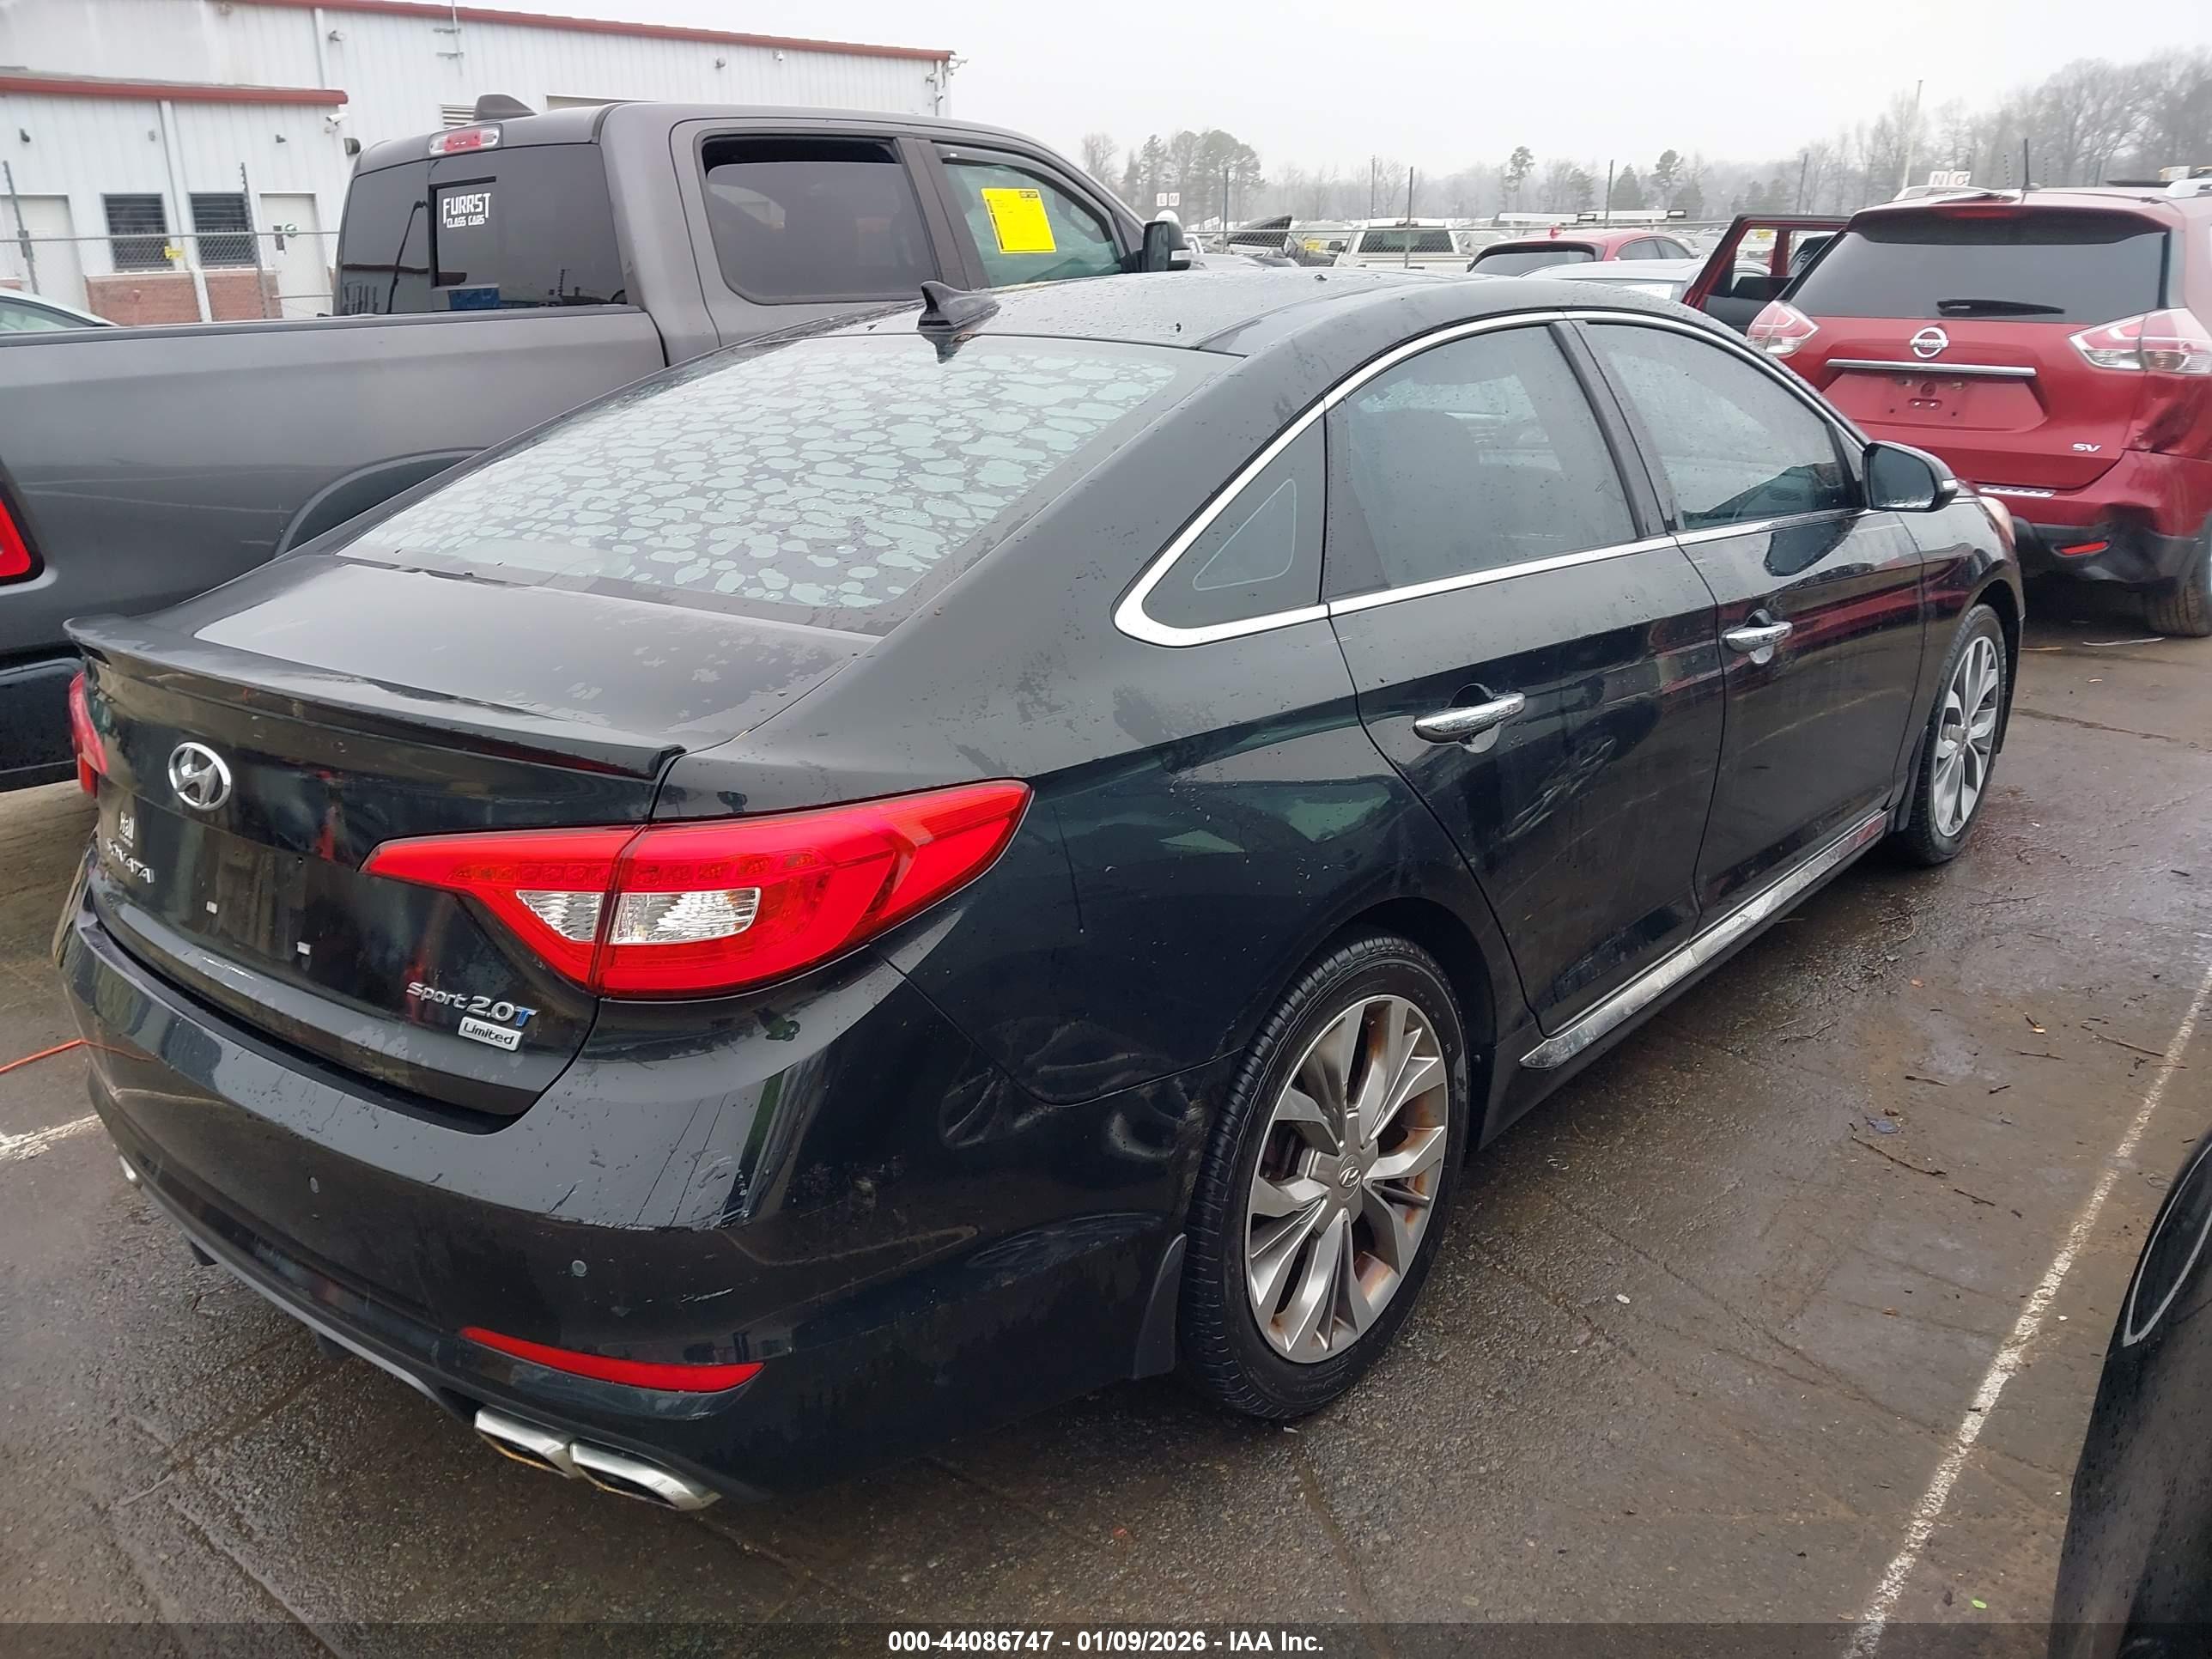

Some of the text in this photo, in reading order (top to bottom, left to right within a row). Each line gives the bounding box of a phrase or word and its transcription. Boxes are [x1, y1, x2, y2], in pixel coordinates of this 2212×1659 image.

[443, 192, 491, 224] FURRST
[2072, 443, 2102, 452] SV
[463, 1022, 515, 1045] Limited
